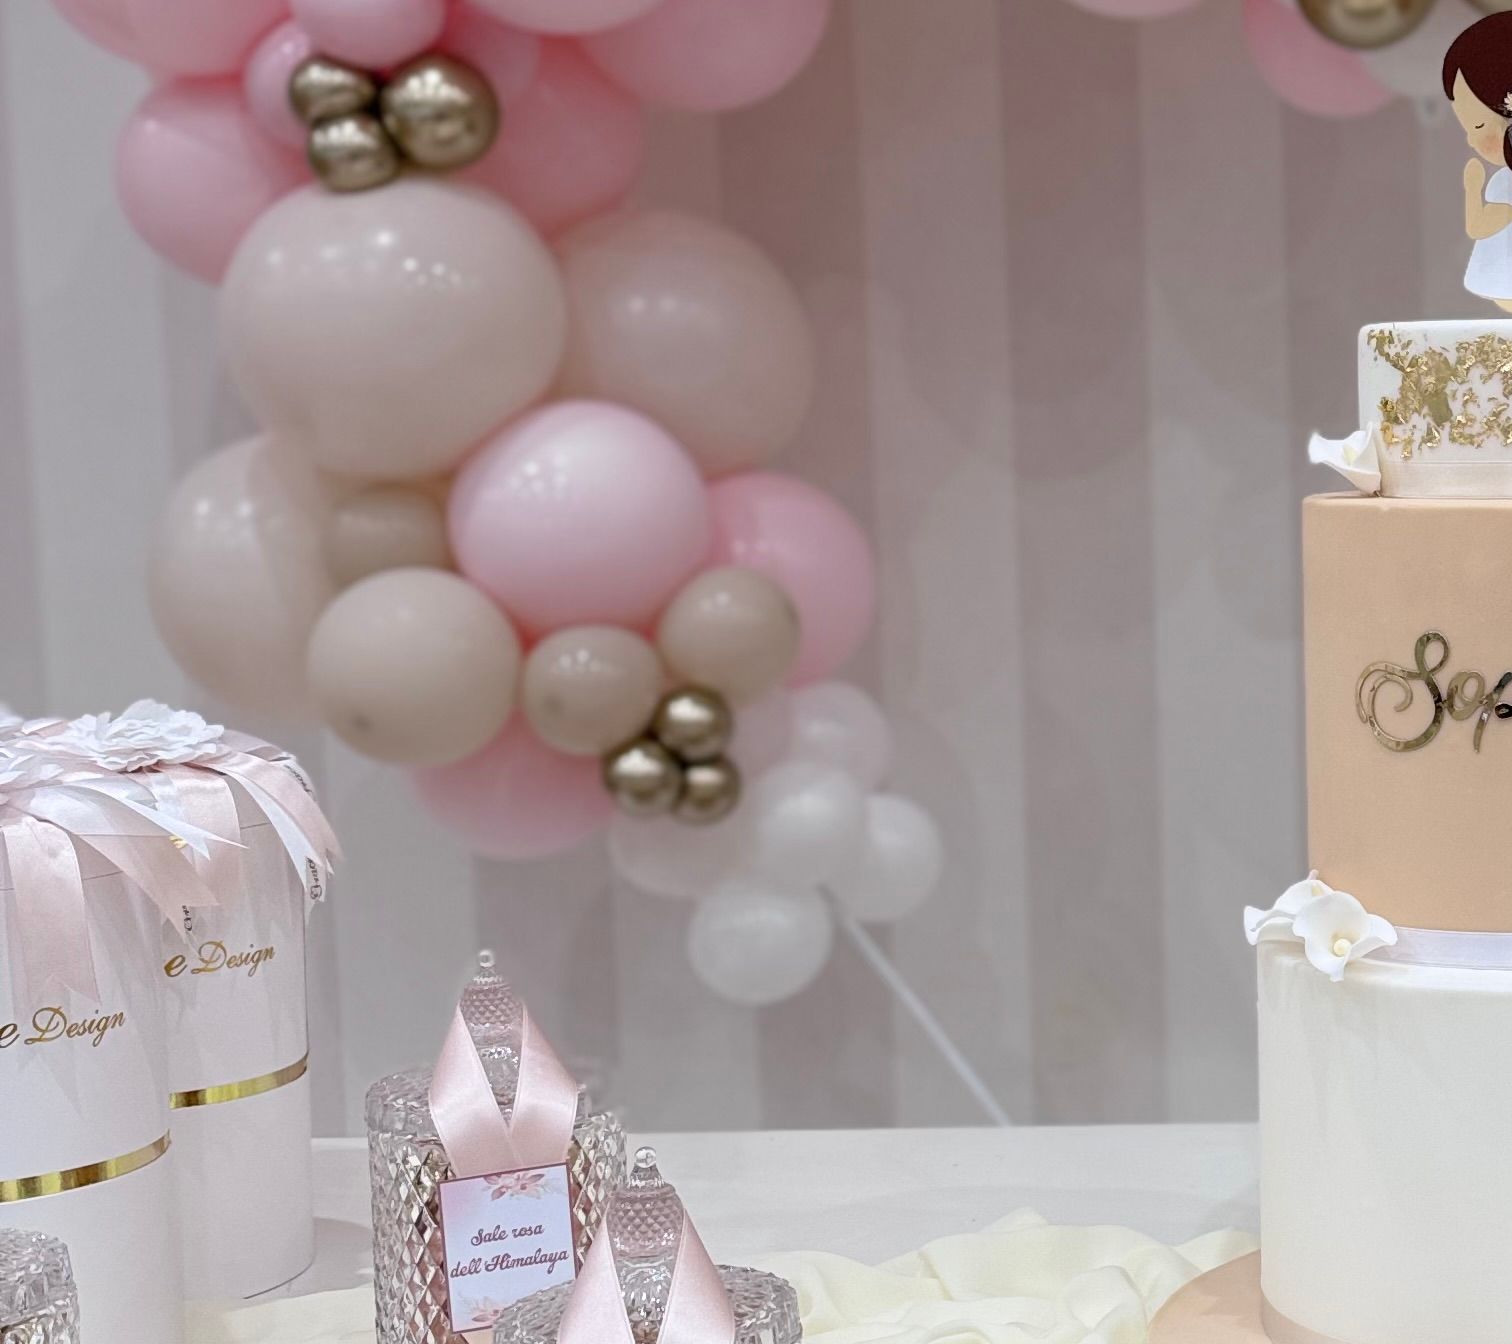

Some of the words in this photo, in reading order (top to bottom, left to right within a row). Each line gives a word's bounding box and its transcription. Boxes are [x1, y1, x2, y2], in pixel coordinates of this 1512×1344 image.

[190, 940, 276, 978] Design
[24, 1006, 126, 1047] Design
[470, 1223, 509, 1247] Sale
[511, 1222, 545, 1240] rosa
[450, 1247, 570, 1278] dell'Himalaya
